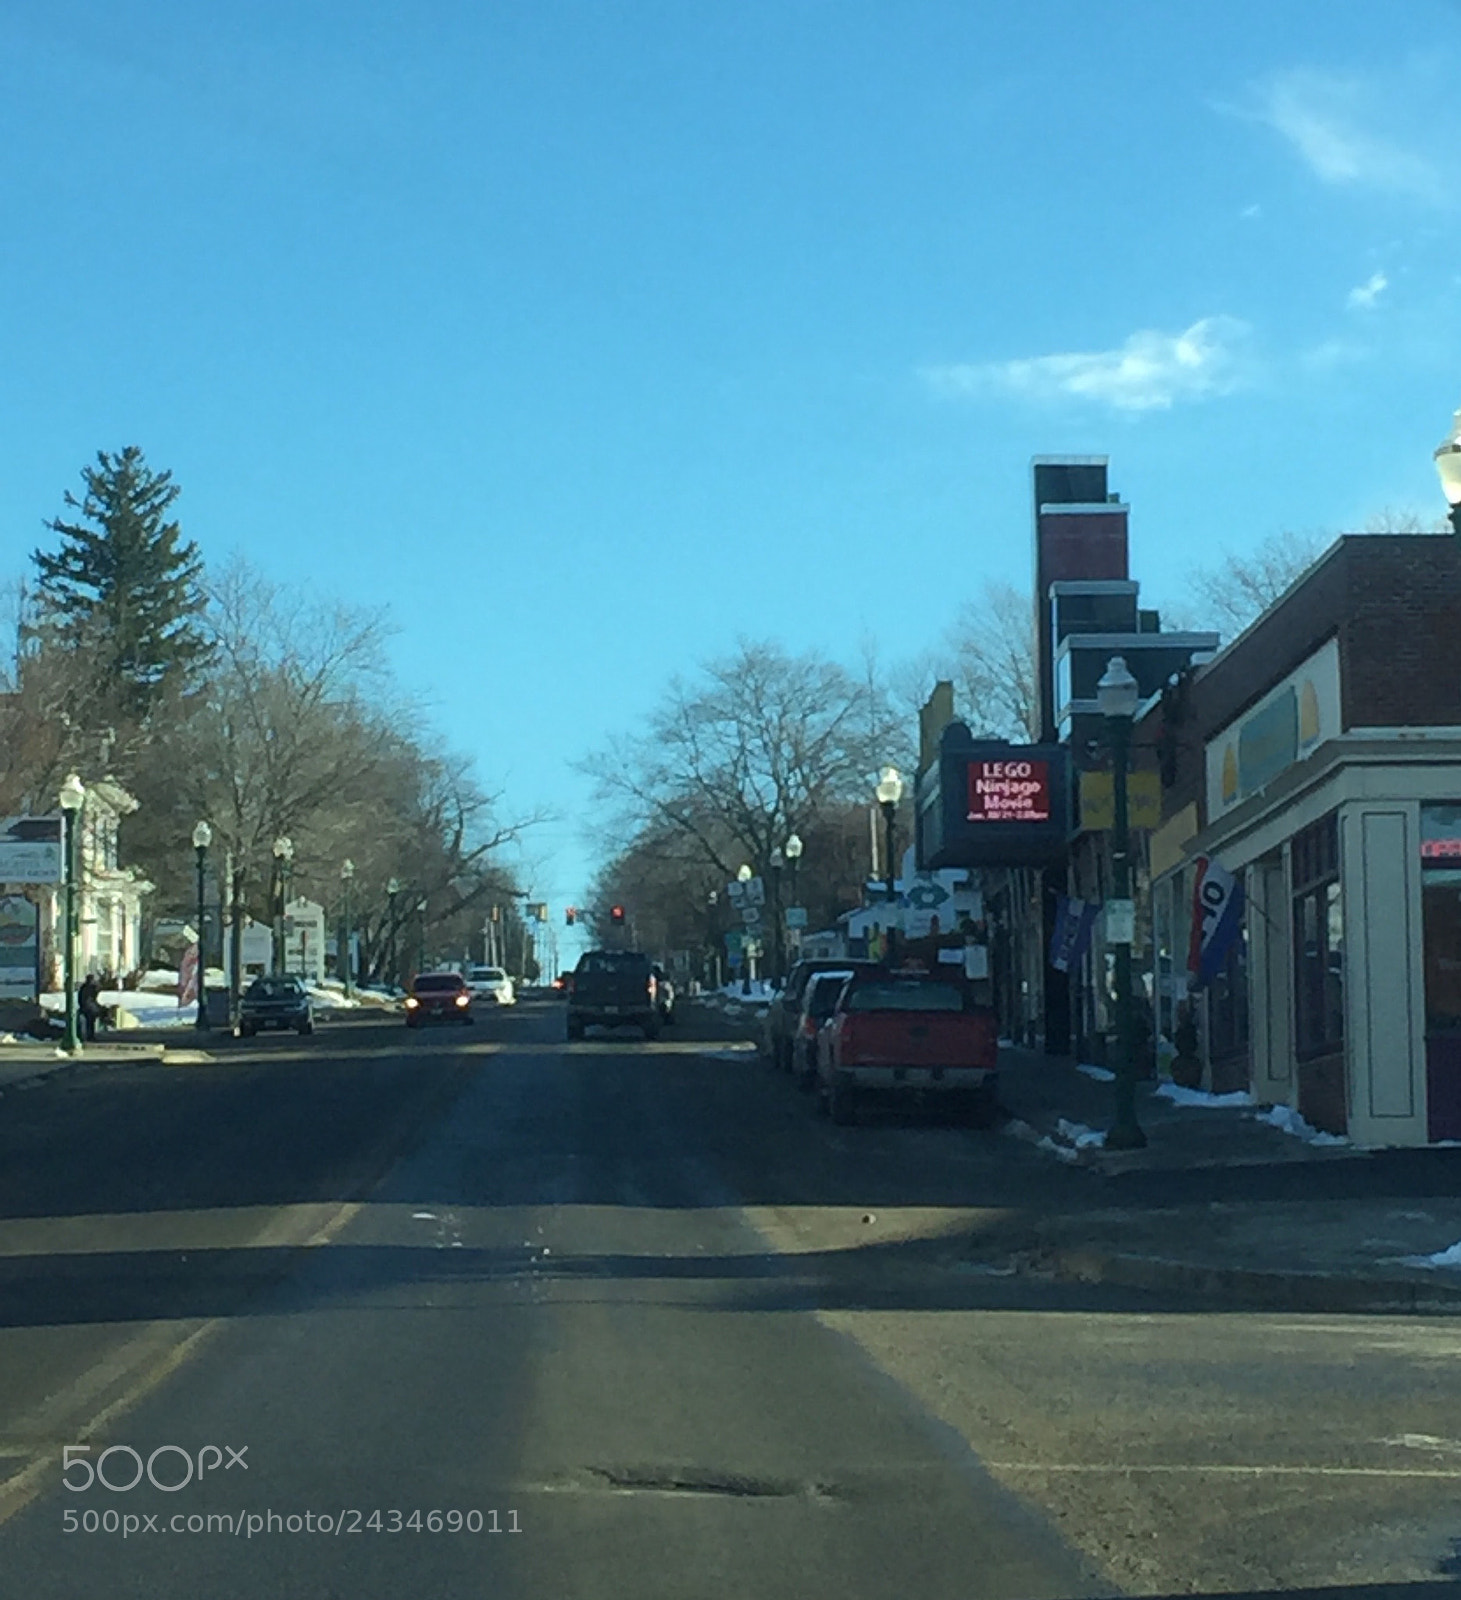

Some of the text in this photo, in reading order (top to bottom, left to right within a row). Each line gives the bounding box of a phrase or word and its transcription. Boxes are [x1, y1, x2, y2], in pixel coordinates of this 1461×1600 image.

[983, 762, 1031, 778] LEGO
[976, 779, 1041, 797] Ninjago
[984, 795, 1033, 810] Movie
